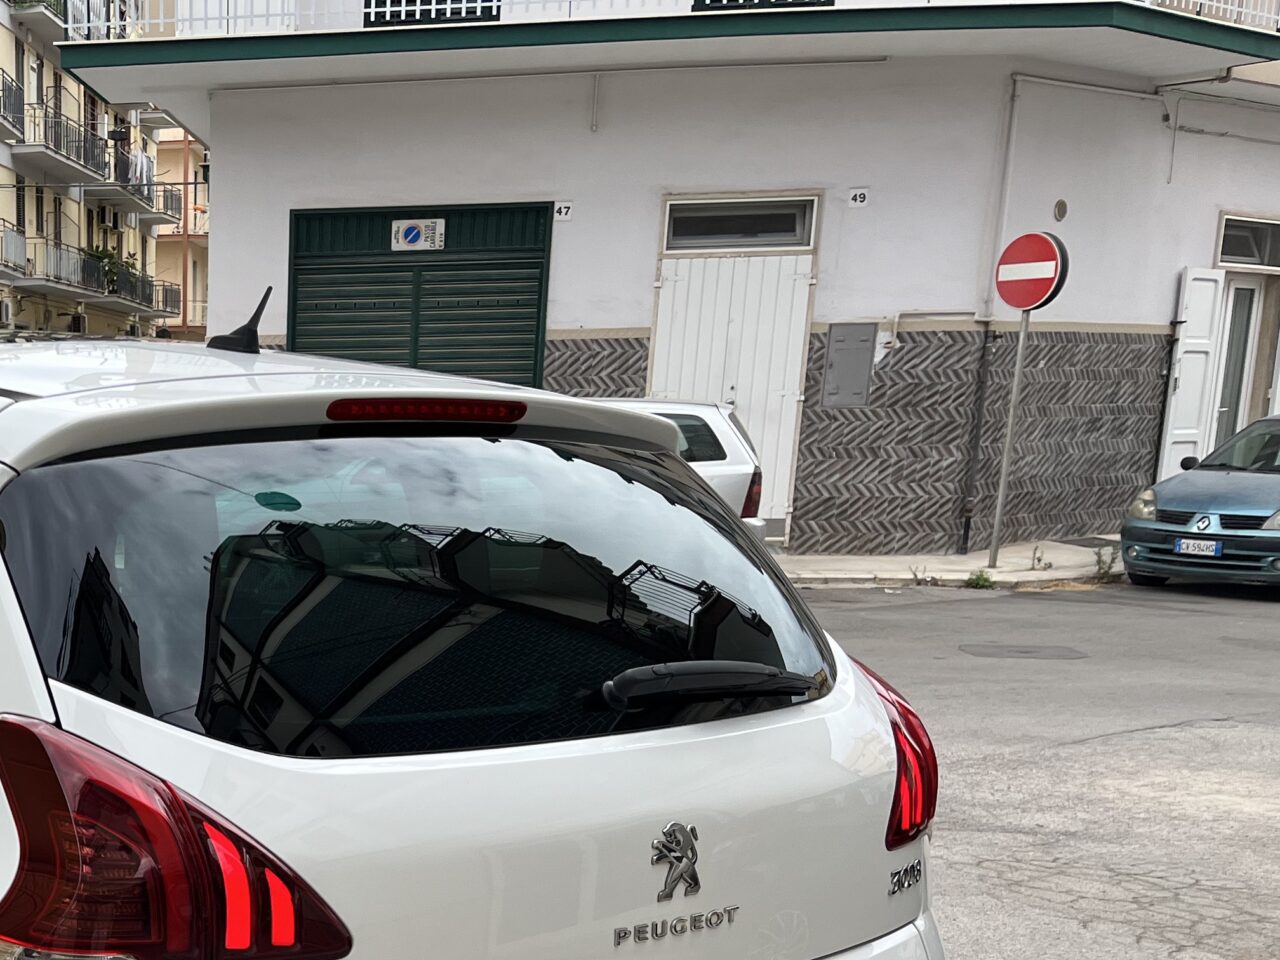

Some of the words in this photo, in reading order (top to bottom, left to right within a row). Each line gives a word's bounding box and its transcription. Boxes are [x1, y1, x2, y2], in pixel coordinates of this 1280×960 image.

[851, 192, 866, 203] 49
[556, 206, 571, 216] 47
[887, 859, 922, 897] 3008
[613, 905, 740, 948] PEUGEOT
